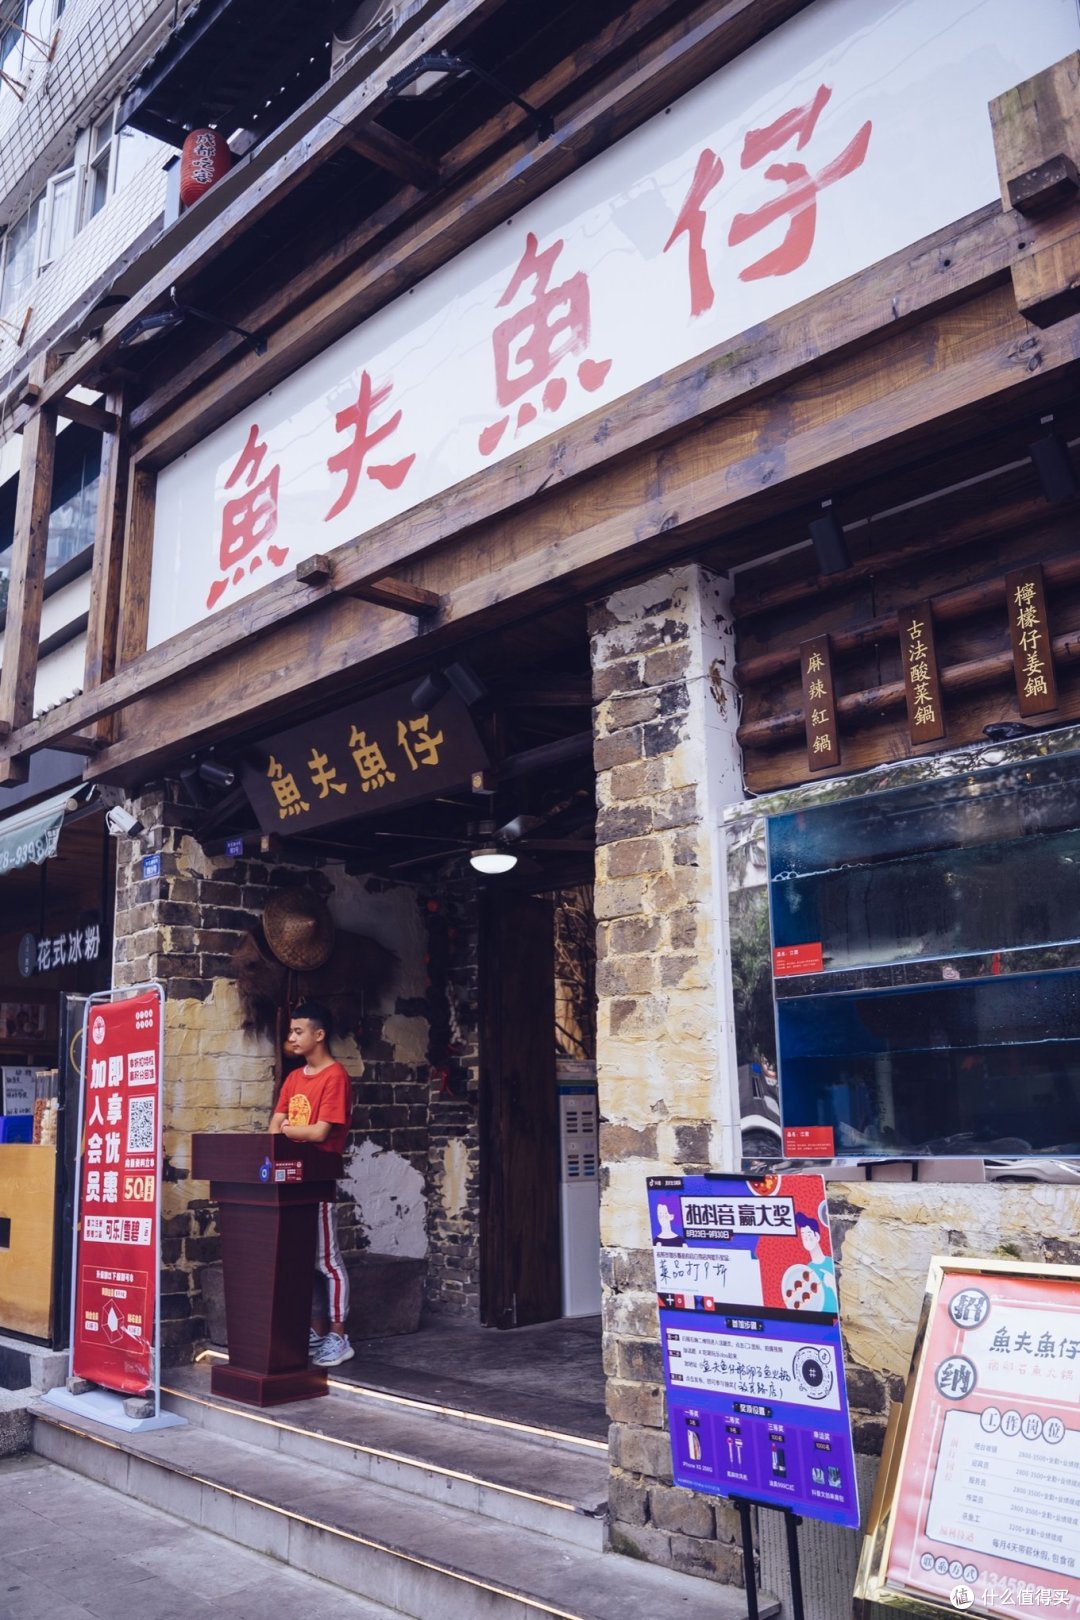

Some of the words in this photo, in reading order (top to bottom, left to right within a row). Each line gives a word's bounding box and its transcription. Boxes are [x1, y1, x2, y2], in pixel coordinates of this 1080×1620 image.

[206, 83, 872, 610] 魚夫魚仔
[907, 620, 935, 726] 古法酸菜鍋
[1013, 583, 1048, 697] 檸檬仔姜鍋
[806, 652, 832, 753] 麻辣紅鍋
[266, 714, 444, 819] 魚夫魚仔
[37, 924, 100, 971] 花式冰粉
[86, 1058, 106, 1203] 加入会员
[102, 1055, 123, 1203] 即享优惠
[685, 1204, 735, 1227] 拍抖音
[738, 1204, 793, 1228] 赢大奖
[989, 1326, 1080, 1360] 魚夫魚仔
[986, 1412, 1061, 1439] 工作岗位
